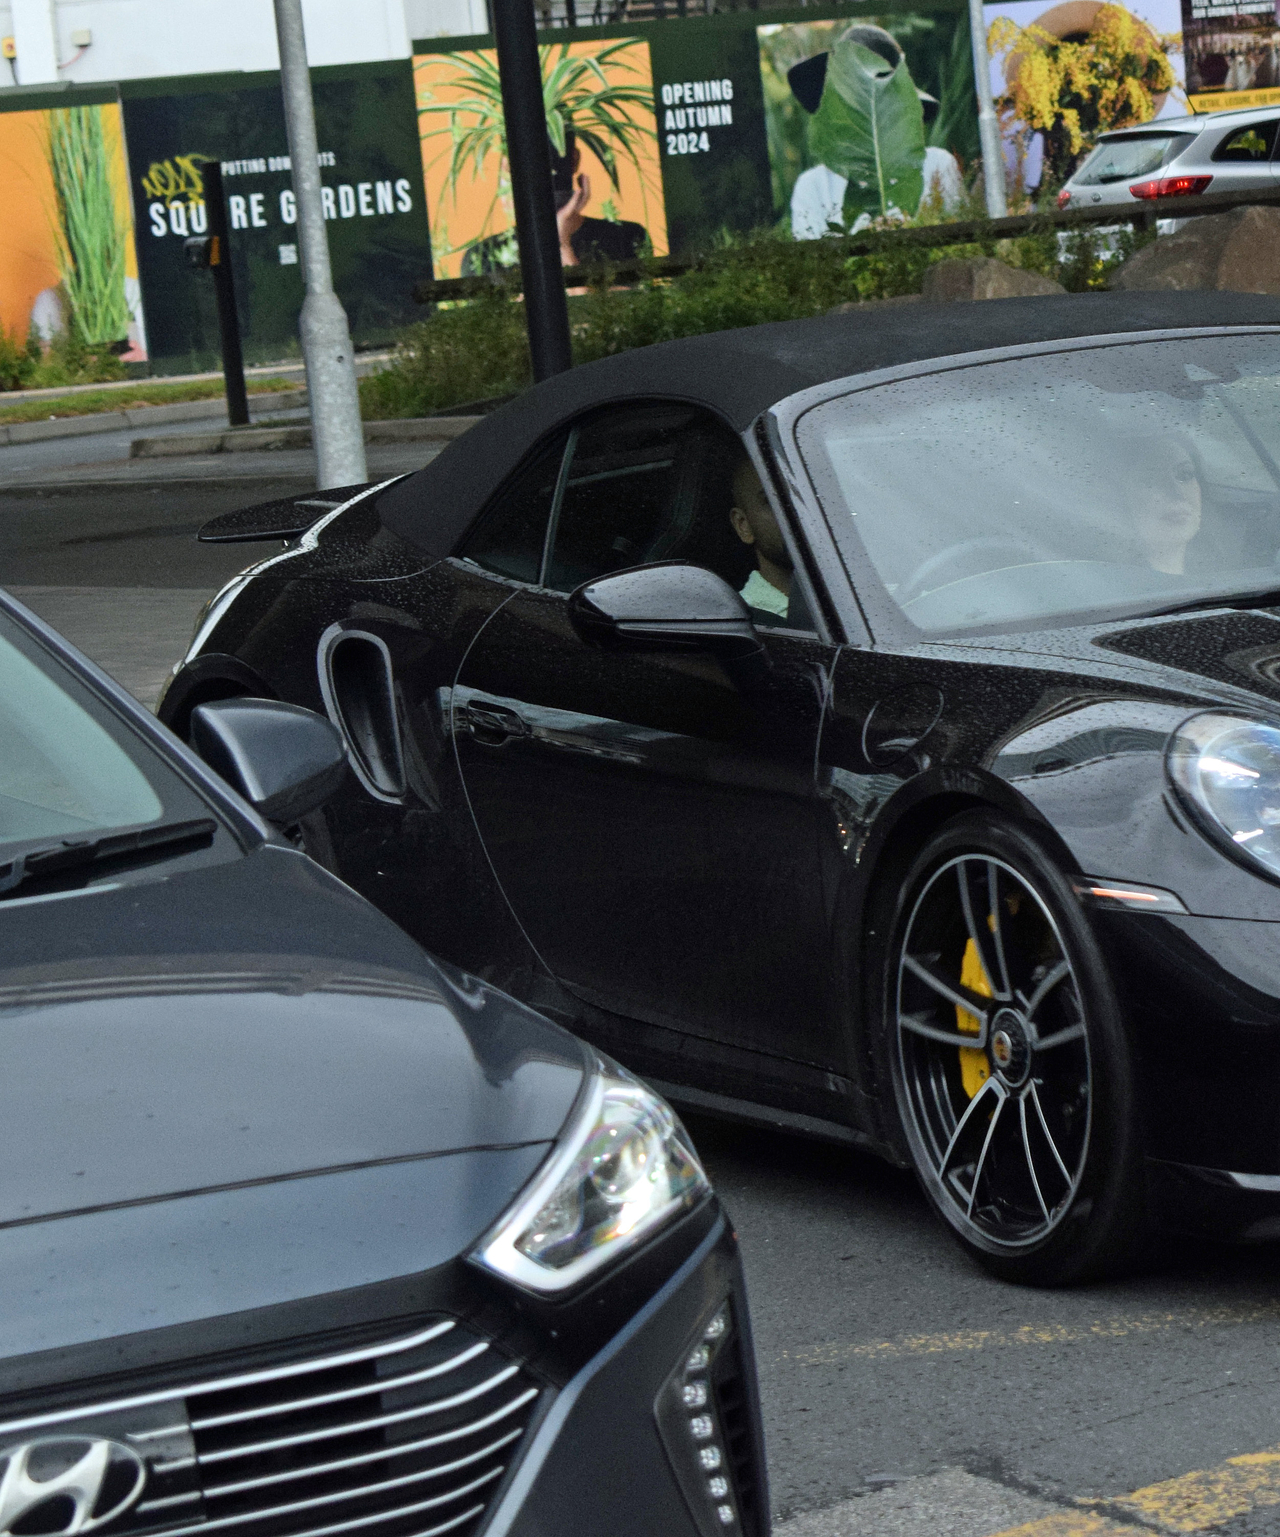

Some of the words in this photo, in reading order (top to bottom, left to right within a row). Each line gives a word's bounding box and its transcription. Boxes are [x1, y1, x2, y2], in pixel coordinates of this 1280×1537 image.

[661, 79, 733, 105] OPENING
[665, 104, 732, 130] AUTUMN
[666, 130, 710, 156] 2024
[220, 157, 266, 177] PUTTING
[268, 155, 292, 172] DOW
[149, 192, 267, 238] SQURE
[279, 178, 413, 225] GRDENS
